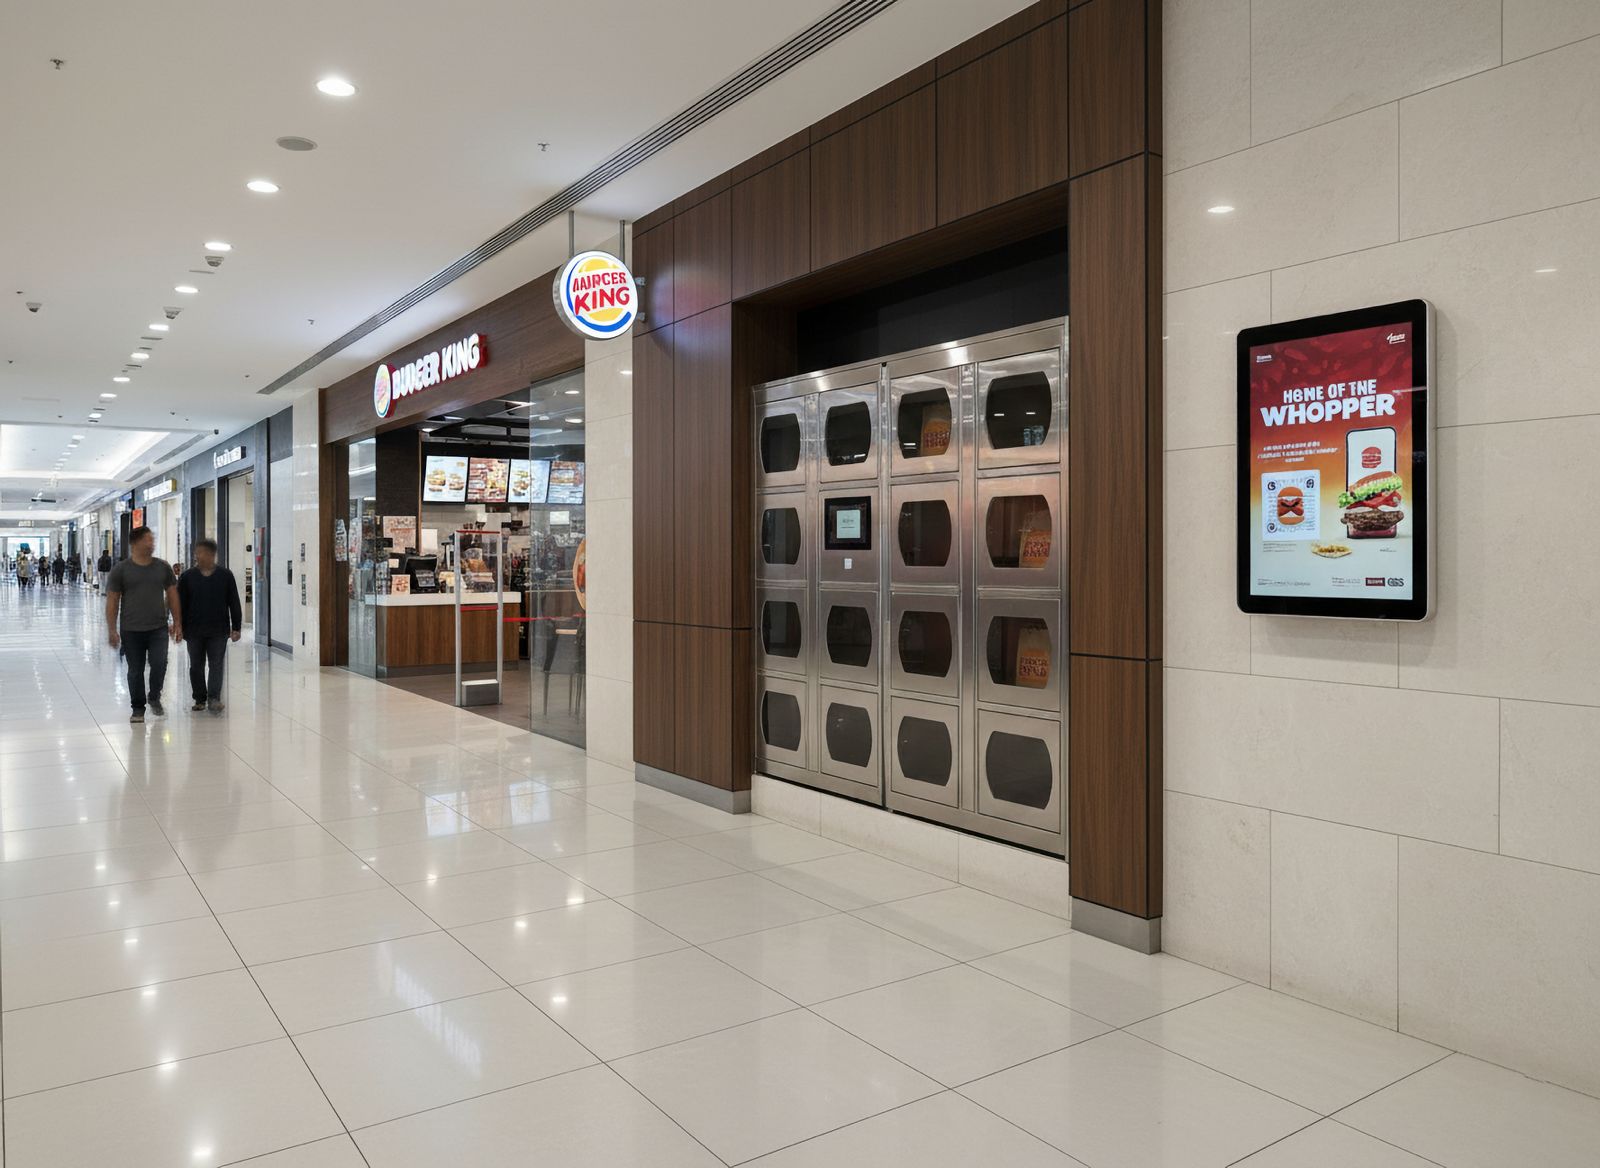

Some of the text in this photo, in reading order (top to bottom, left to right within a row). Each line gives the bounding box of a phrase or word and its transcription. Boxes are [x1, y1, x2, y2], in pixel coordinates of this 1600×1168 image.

[575, 286, 630, 316] KING
[441, 333, 480, 381] KING
[1328, 382, 1346, 399] OF
[1260, 393, 1396, 427] WHOPPER
